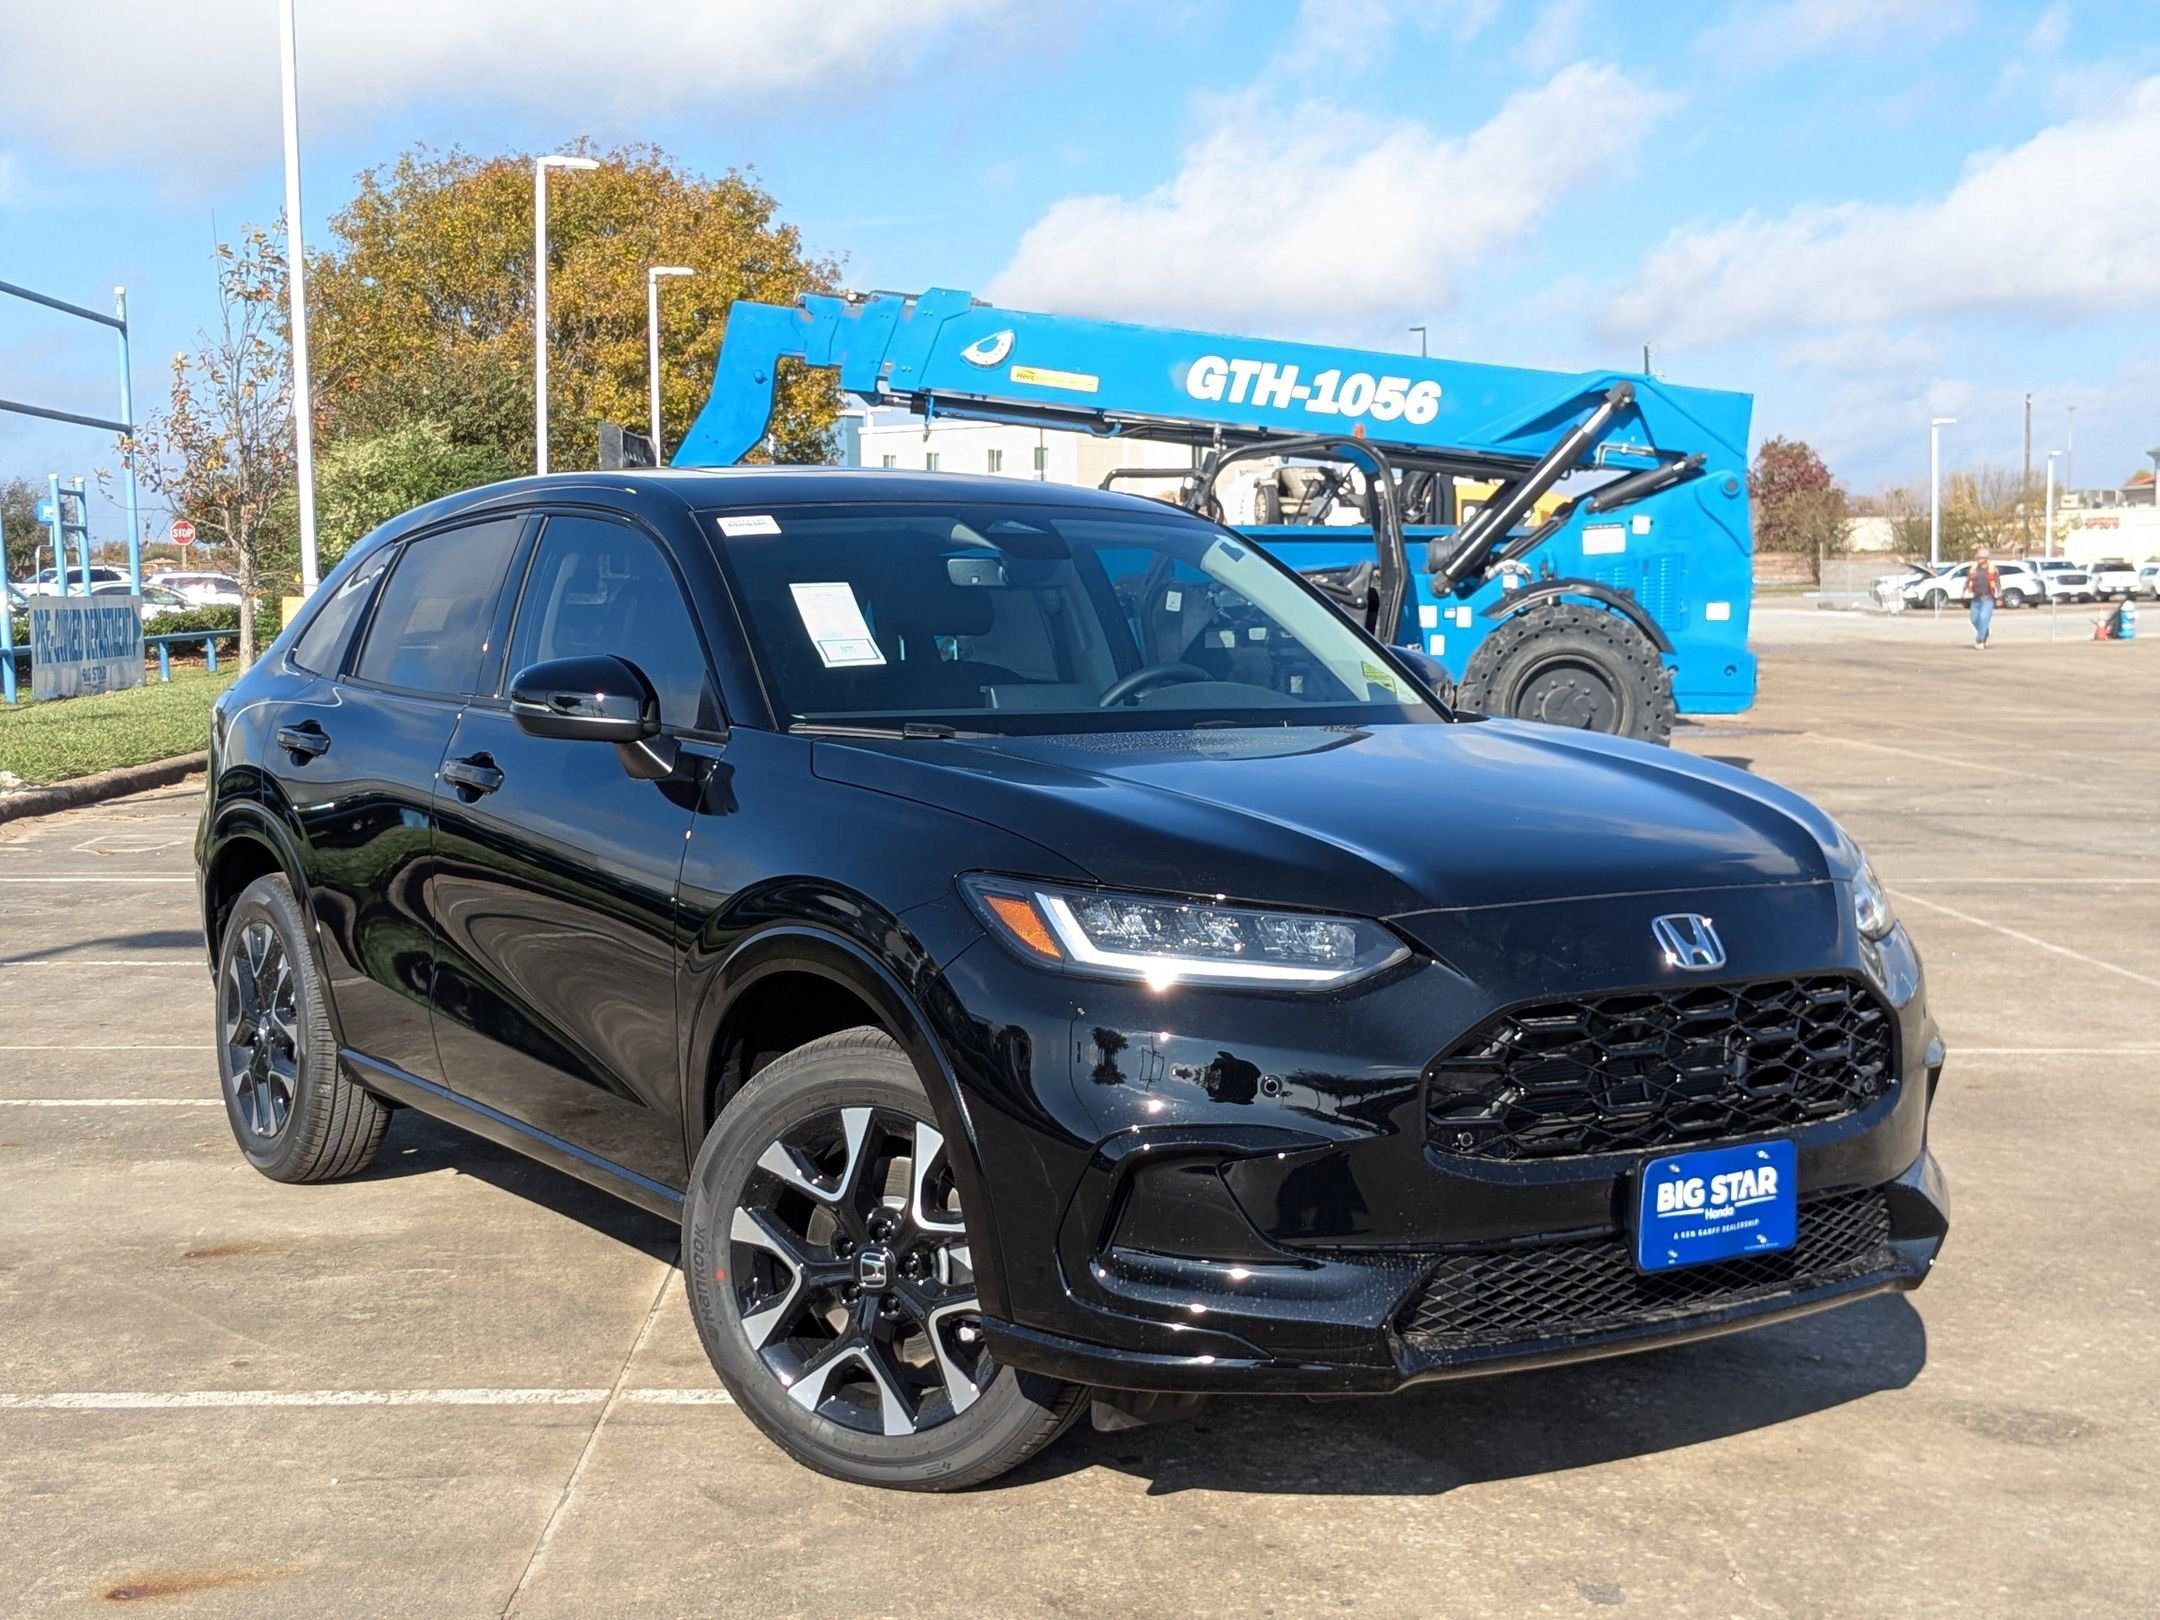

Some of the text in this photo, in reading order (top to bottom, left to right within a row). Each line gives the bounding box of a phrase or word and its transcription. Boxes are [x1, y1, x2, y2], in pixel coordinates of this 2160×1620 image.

[1186, 355, 1442, 425] GTH-1056
[173, 528, 193, 537] STOP
[34, 607, 137, 664] PRE-OWNED DEPARTMENT
[1657, 1166, 1778, 1212] BIG STAR
[1673, 1232, 1679, 1240] A
[1722, 1218, 1760, 1233] DEALERSHIP
[1705, 1204, 1735, 1220] Honda
